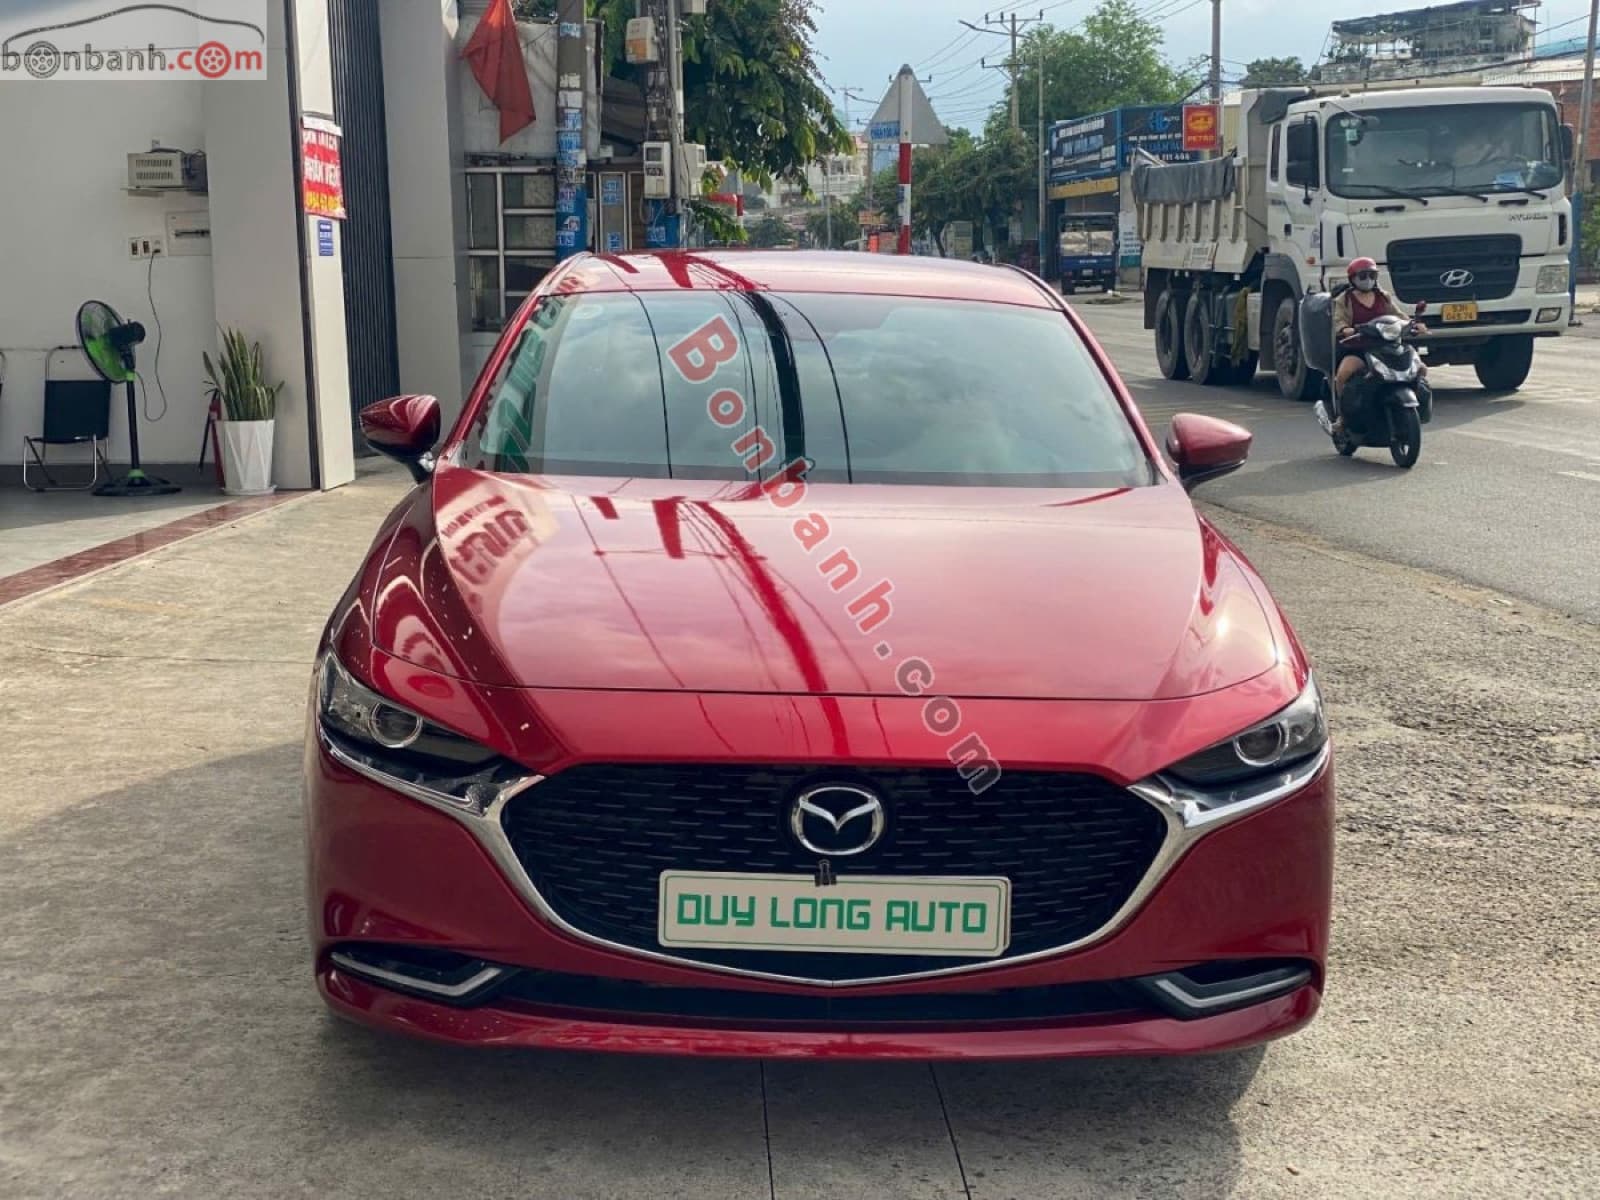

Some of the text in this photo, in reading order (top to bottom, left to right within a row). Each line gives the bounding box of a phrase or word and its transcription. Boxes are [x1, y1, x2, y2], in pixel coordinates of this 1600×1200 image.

[676, 893, 988, 934] DUY LONG AUTO
